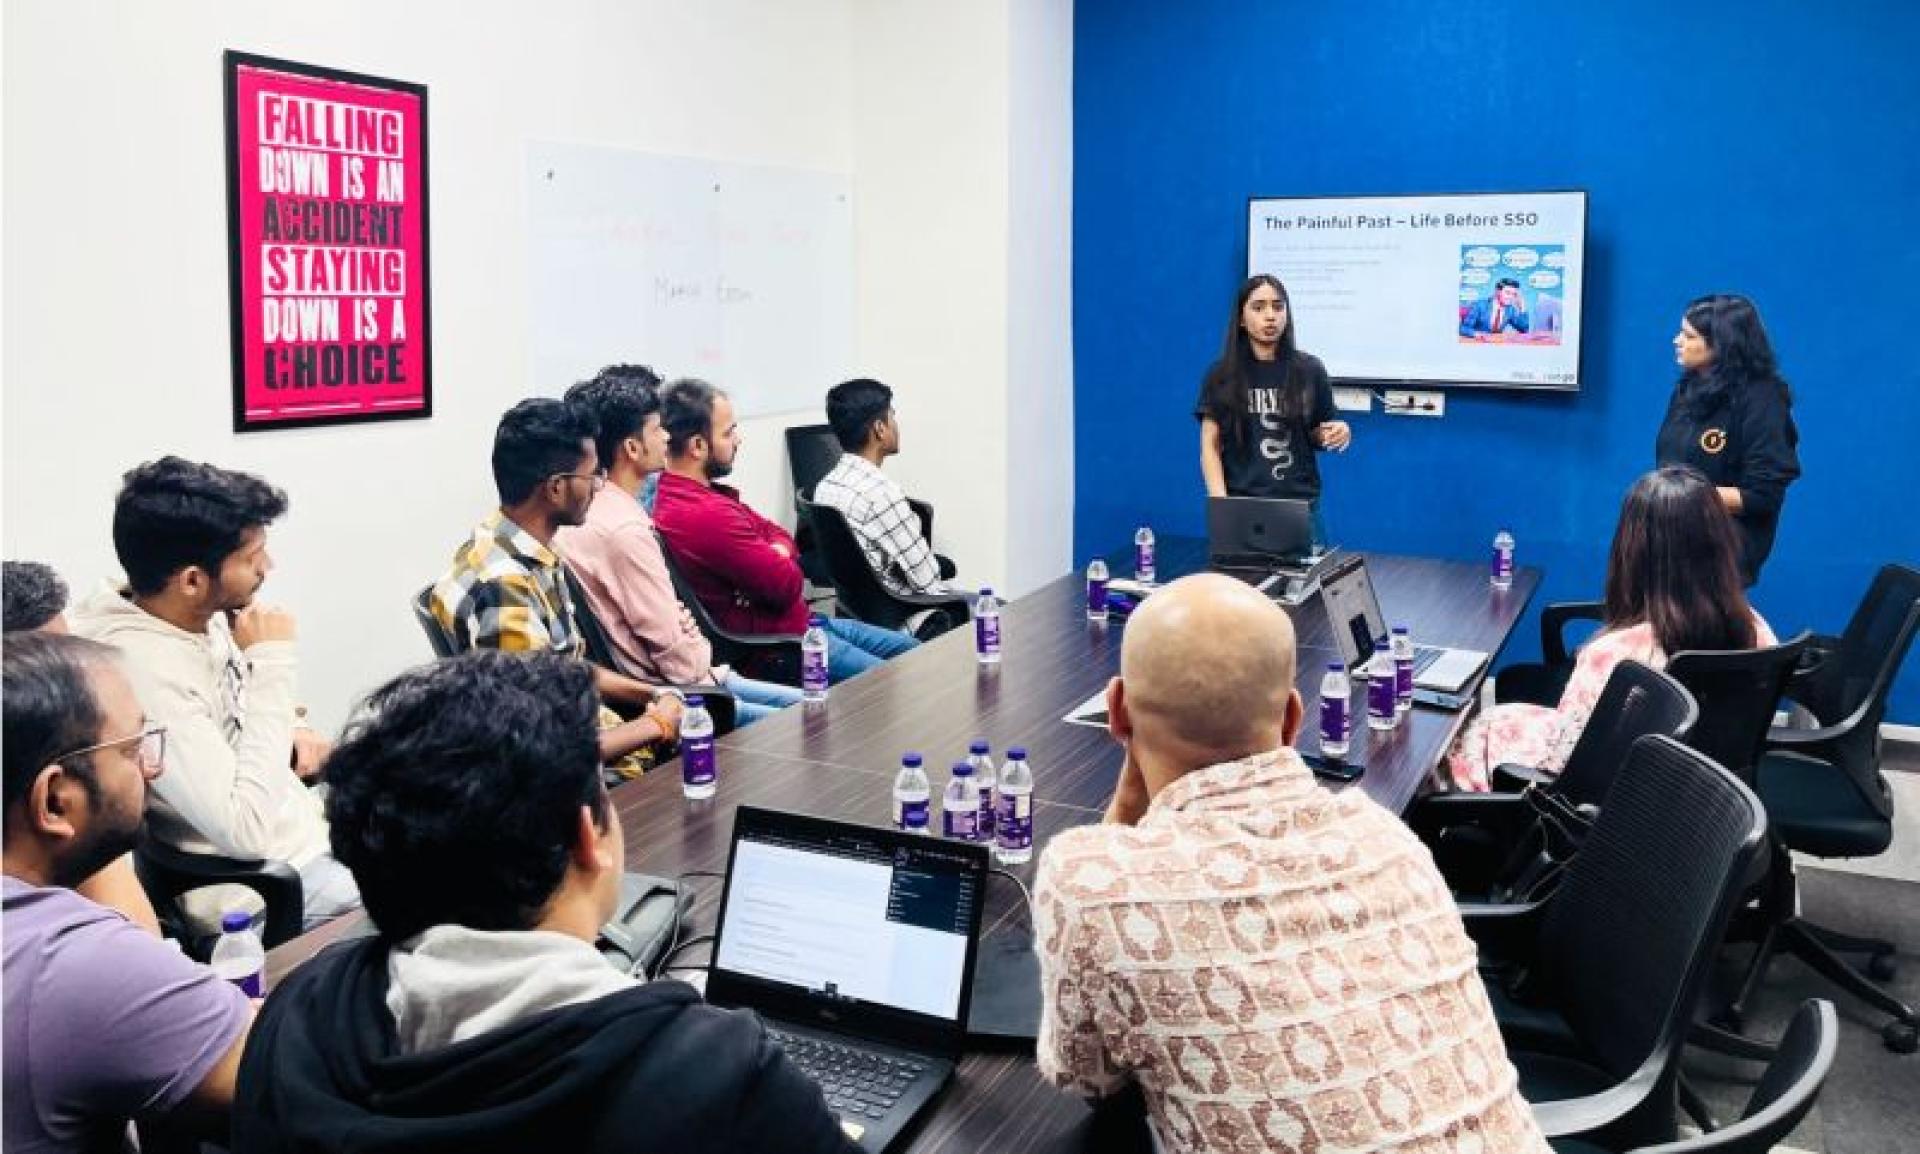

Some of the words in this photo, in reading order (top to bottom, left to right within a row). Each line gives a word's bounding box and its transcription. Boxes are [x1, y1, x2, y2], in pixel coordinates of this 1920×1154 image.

[265, 96, 399, 155] FALLING
[259, 147, 329, 197] DOWN
[342, 155, 365, 200] IS
[376, 162, 404, 203] AN
[263, 196, 404, 246] ACCIDENT
[1265, 216, 1292, 230] The
[1297, 215, 1352, 229] Painful
[1357, 215, 1391, 229] Past
[1410, 213, 1441, 229] Life
[1444, 213, 1499, 227] Before
[1503, 212, 1538, 227] SSO
[268, 246, 401, 292] STAYING
[263, 297, 340, 343] DOWN
[354, 298, 378, 342] IS
[390, 298, 407, 342] A
[264, 343, 407, 390] CHOICE
